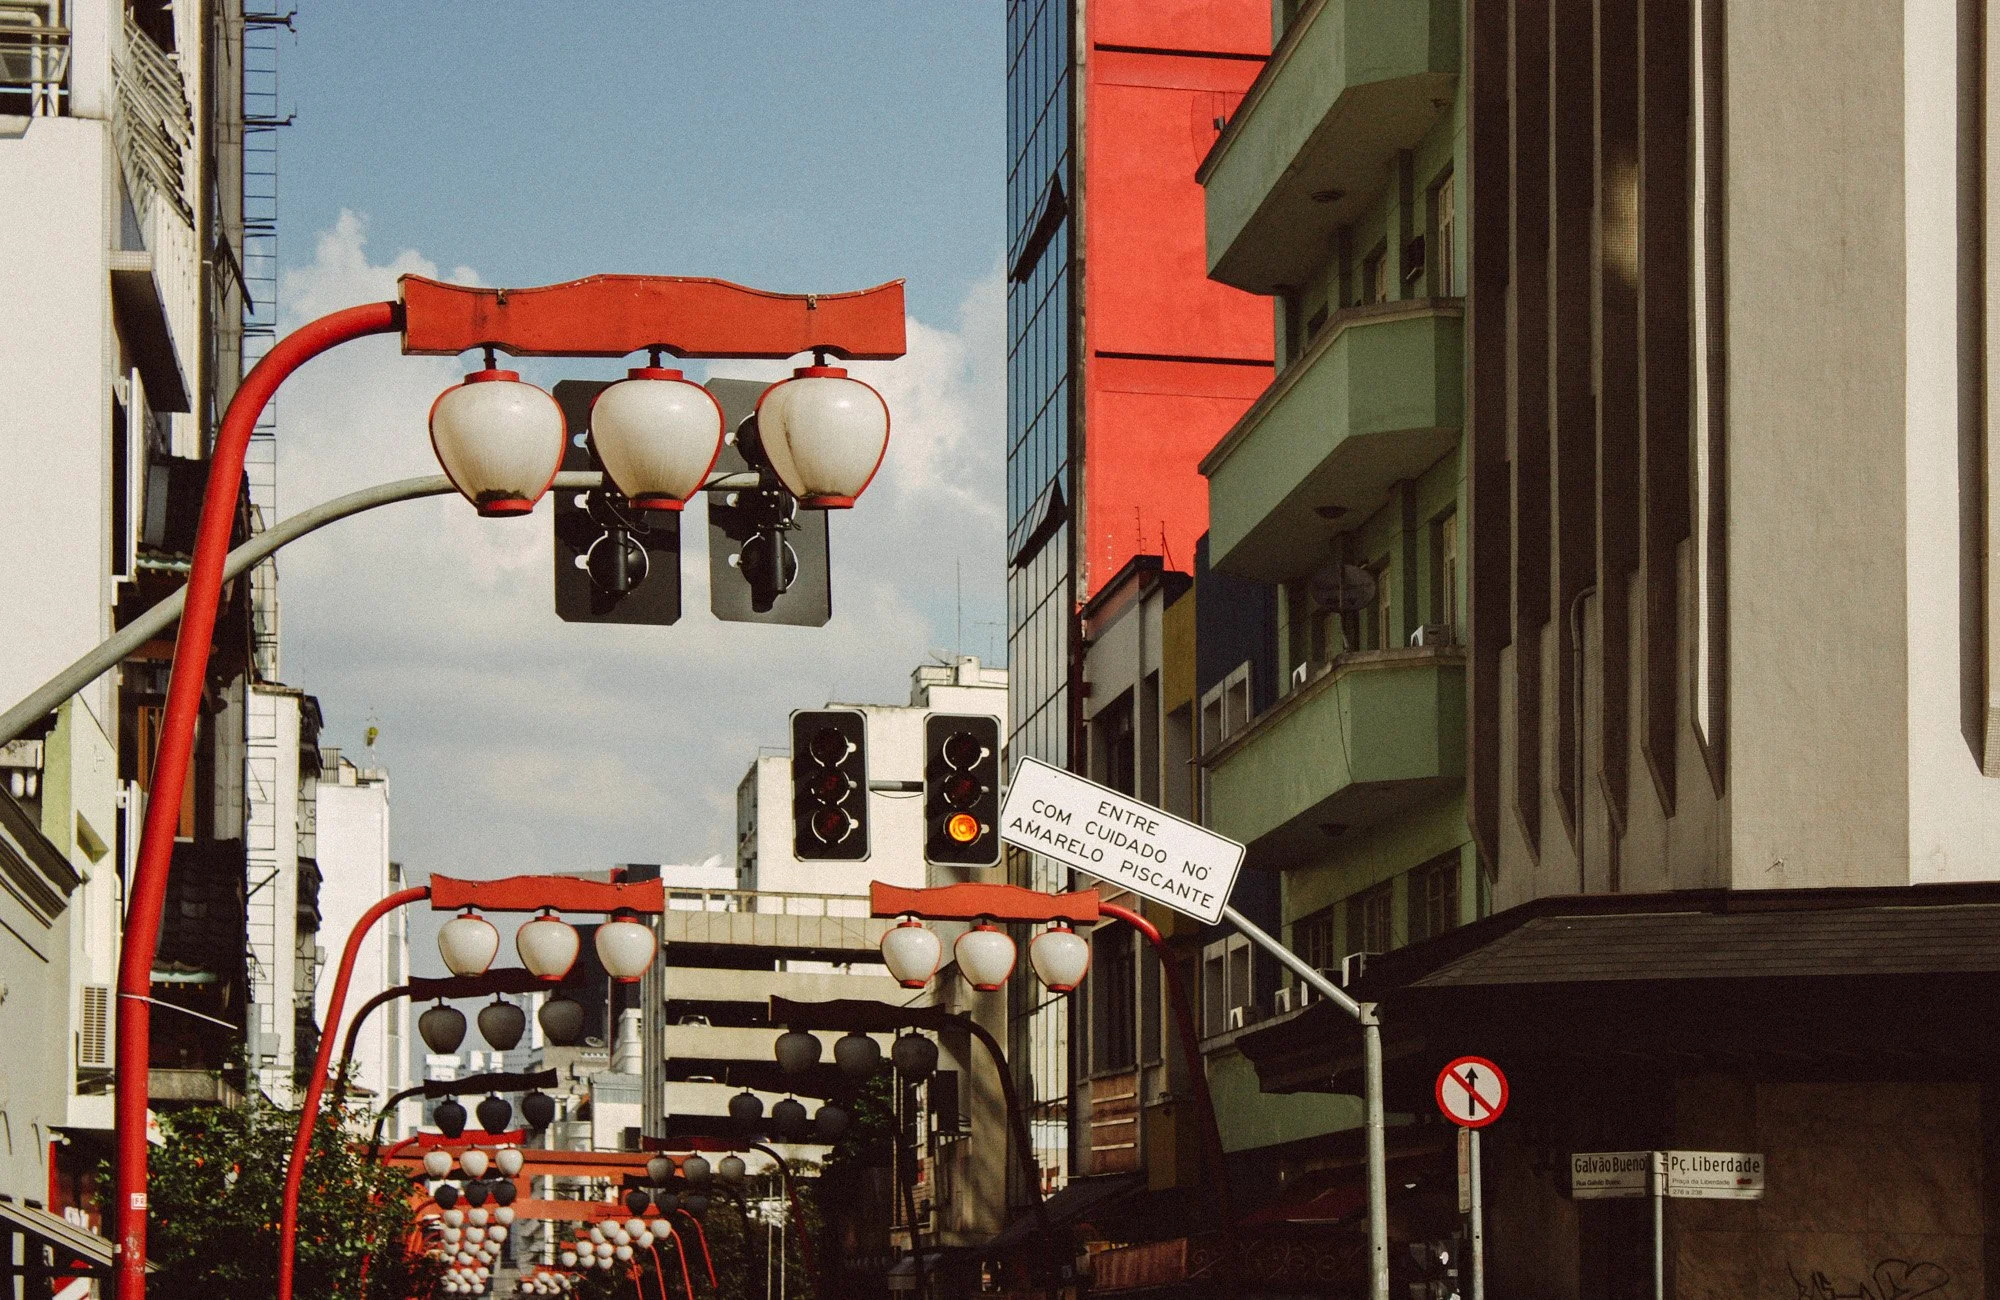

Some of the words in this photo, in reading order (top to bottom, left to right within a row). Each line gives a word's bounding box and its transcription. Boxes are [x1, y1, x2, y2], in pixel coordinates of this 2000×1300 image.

[1097, 801, 1159, 836] ENTRE
[1032, 799, 1072, 825] COM
[1085, 821, 1167, 863] CUIDADO
[1182, 860, 1208, 881] NO
[1010, 817, 1104, 863] AMARELO
[1120, 860, 1215, 909] PISCANTE
[1575, 1157, 1611, 1173] Galvão
[1613, 1157, 1646, 1173] Bueno
[1671, 1156, 1690, 1175] Pç.
[1692, 1156, 1761, 1173] Liberdade
